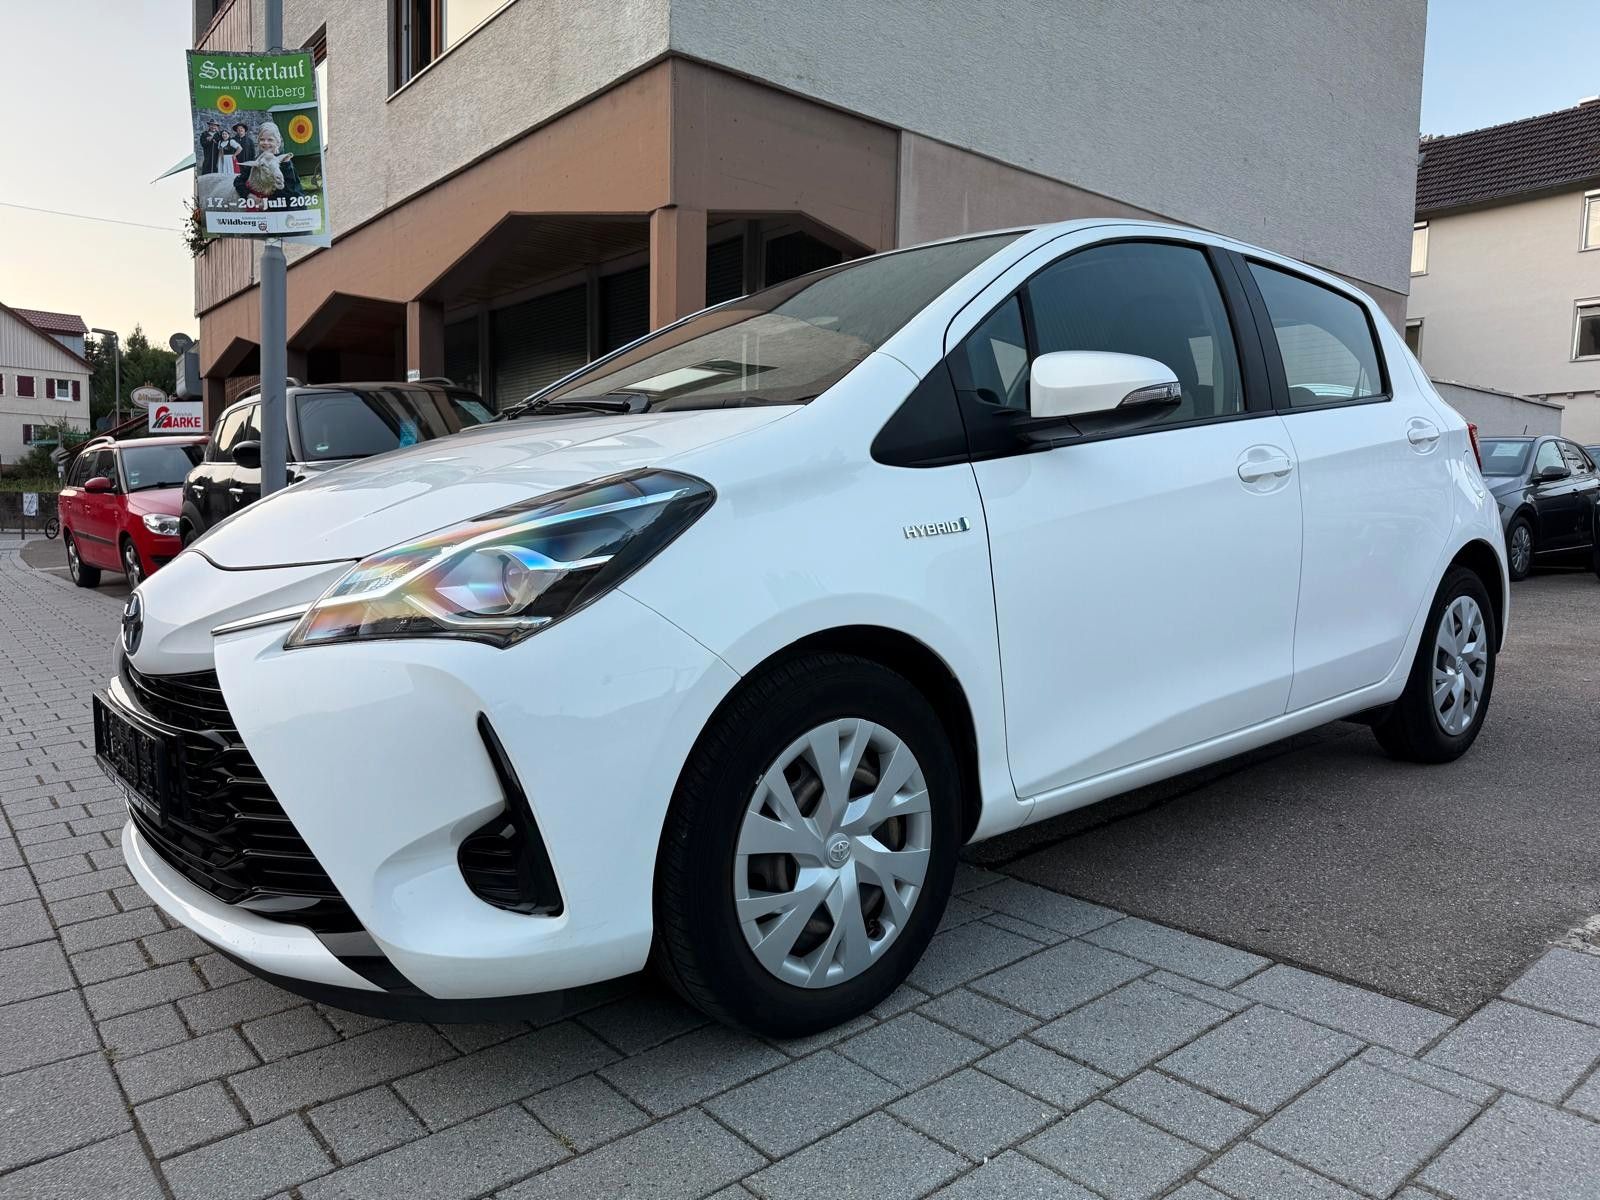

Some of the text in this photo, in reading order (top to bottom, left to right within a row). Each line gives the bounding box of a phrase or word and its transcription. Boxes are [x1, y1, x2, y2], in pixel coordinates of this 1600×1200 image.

[199, 59, 305, 84] Schäferlauf
[243, 85, 305, 99] Wildberg
[262, 197, 287, 210] Juli
[289, 194, 319, 207] 2026
[216, 218, 257, 227] Wildberg
[903, 520, 961, 539] HYBRID
